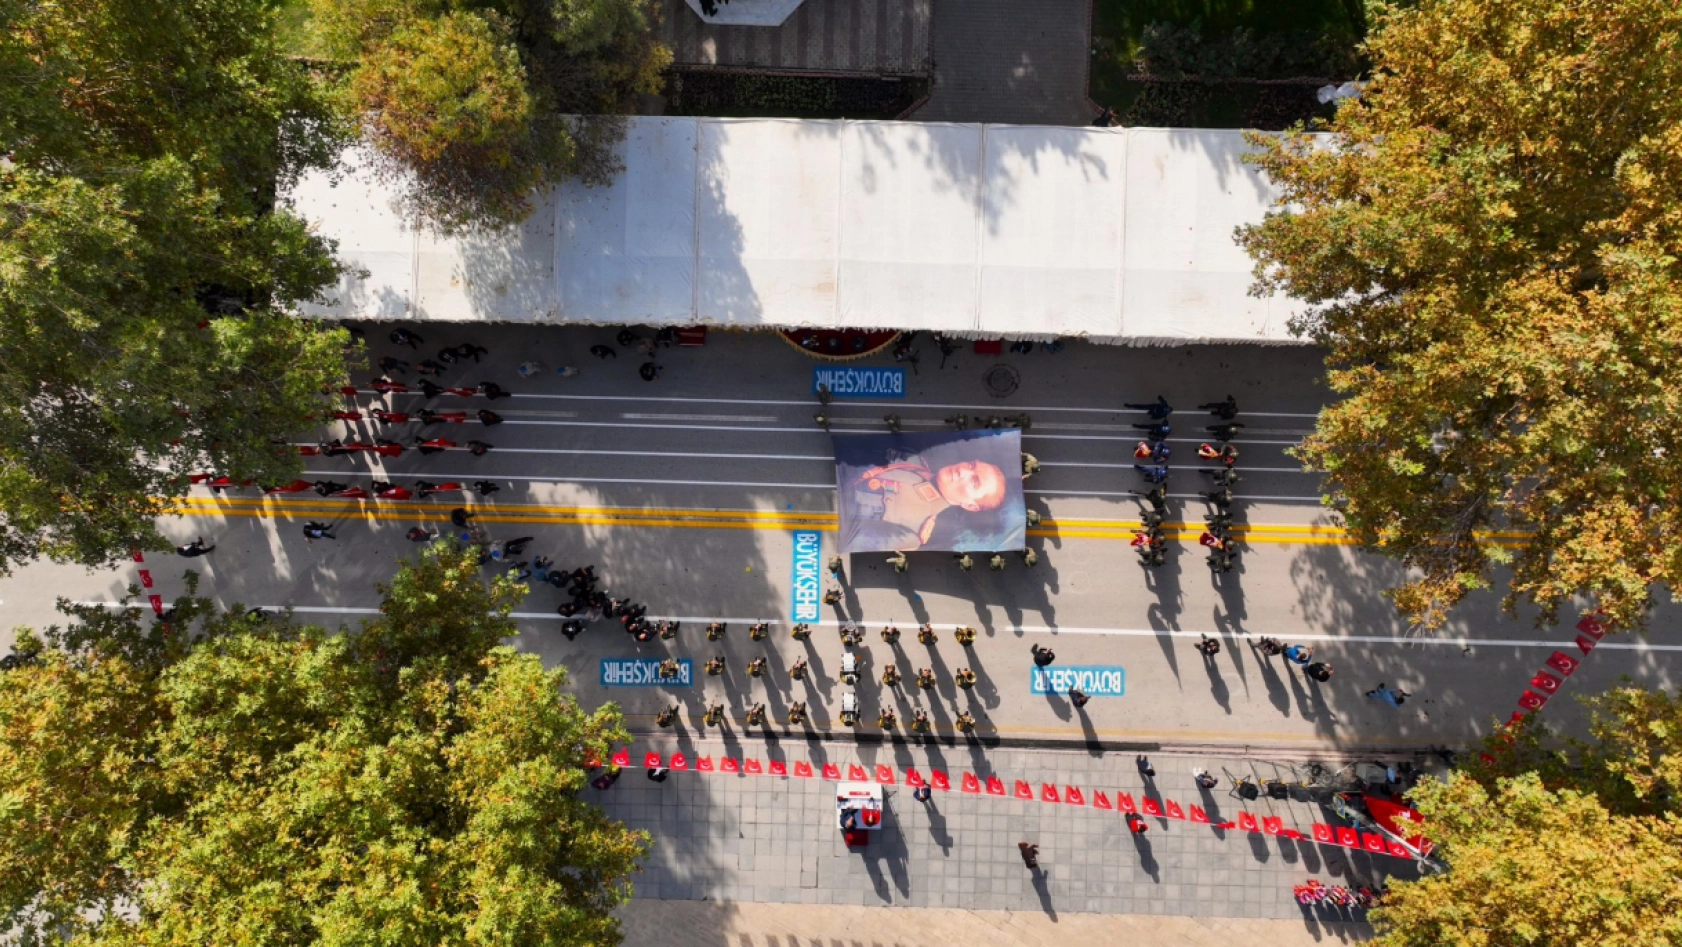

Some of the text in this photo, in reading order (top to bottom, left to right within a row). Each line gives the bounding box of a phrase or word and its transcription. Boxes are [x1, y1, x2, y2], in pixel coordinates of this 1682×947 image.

[793, 533, 819, 620] BÜYÜKŞEHİR
[603, 660, 690, 684] BÜKŞEHİR
[1034, 668, 1121, 693] BÜYÜKŞEHİR
